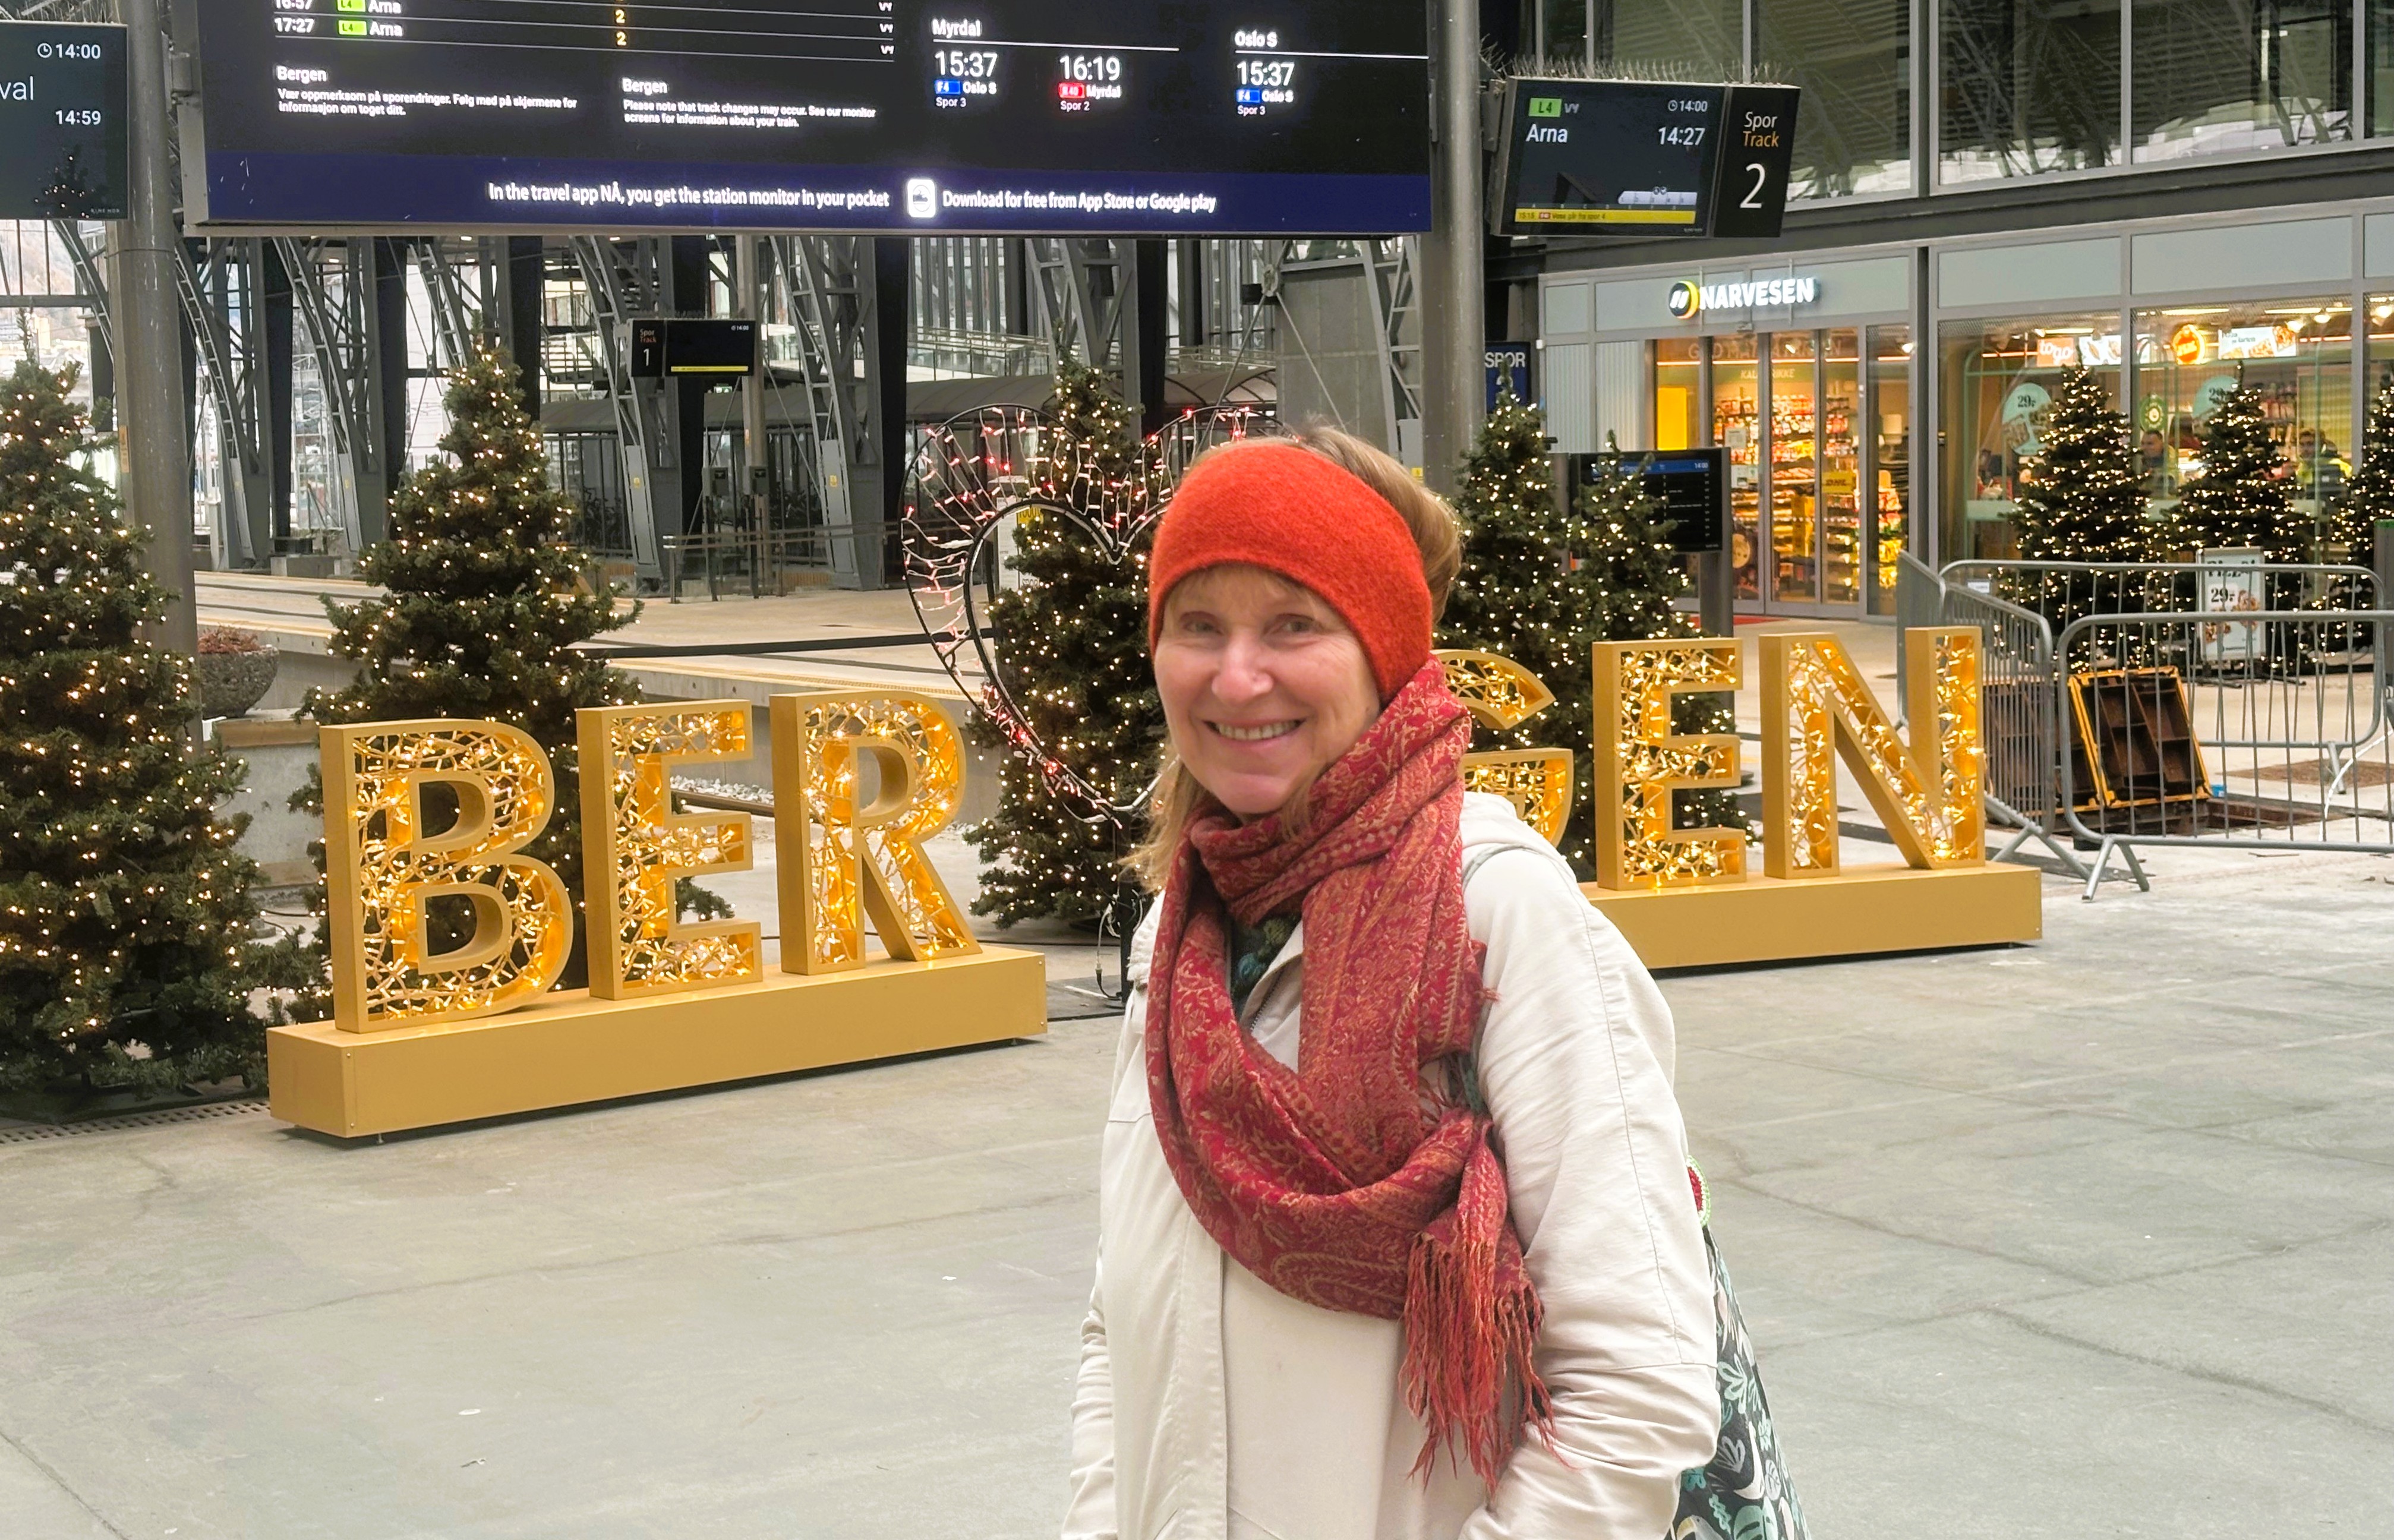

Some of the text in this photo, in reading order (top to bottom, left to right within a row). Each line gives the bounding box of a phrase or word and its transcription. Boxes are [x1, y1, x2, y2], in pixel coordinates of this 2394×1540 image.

[340, 0, 352, 8] L4
[368, 0, 402, 14] Arna
[616, 10, 625, 23] 2
[275, 17, 314, 33] 17:27
[342, 23, 354, 31] L4
[369, 21, 403, 37] Arna
[616, 31, 627, 46] 2
[932, 18, 981, 39] Myrdal
[1235, 30, 1278, 48] Oslo S
[55, 43, 102, 59] 14:00
[935, 51, 998, 77] 15:37
[1059, 55, 1121, 81] 16:19
[1237, 61, 1295, 86] 15:37
[277, 65, 327, 84] Bergen
[623, 77, 668, 96] Bergen
[936, 81, 998, 94] F4 Oslo S
[1086, 84, 1121, 100] Myrdal
[1238, 89, 1294, 103] F4 Oslo S
[301, 90, 366, 102] oppmerksom
[368, 90, 381, 103] på
[383, 93, 452, 106] sporendringer.
[476, 95, 498, 106] med
[499, 94, 512, 108] på
[513, 96, 562, 109] skjermene
[563, 97, 578, 109] for
[623, 99, 876, 118] Please note that track changes may occur. See our monitor
[935, 97, 967, 109] Spor 3
[1060, 100, 1090, 112] Spor 2
[1538, 101, 1553, 113] L4
[1679, 100, 1708, 112] 14:00
[55, 110, 102, 125] 14:59
[340, 105, 357, 114] om
[358, 105, 385, 117] toget
[387, 105, 406, 115] ditt.
[1237, 105, 1266, 116] Spor 3
[624, 113, 800, 128] screens for information about your train.
[1743, 111, 1778, 131] Spor
[1525, 123, 1569, 143] Arna
[1658, 127, 1706, 146] 14:27
[1742, 130, 1780, 147] Track
[489, 181, 890, 210] In the travel app NÅ, you get the station monitor in your pocket
[1739, 163, 1766, 209] 2
[942, 190, 1217, 214] Download for free from App Store or Google play
[1699, 277, 1815, 311] NARVESEN
[643, 348, 650, 366] 1
[1484, 352, 1525, 368] SPOR
[320, 690, 982, 1033] BER
